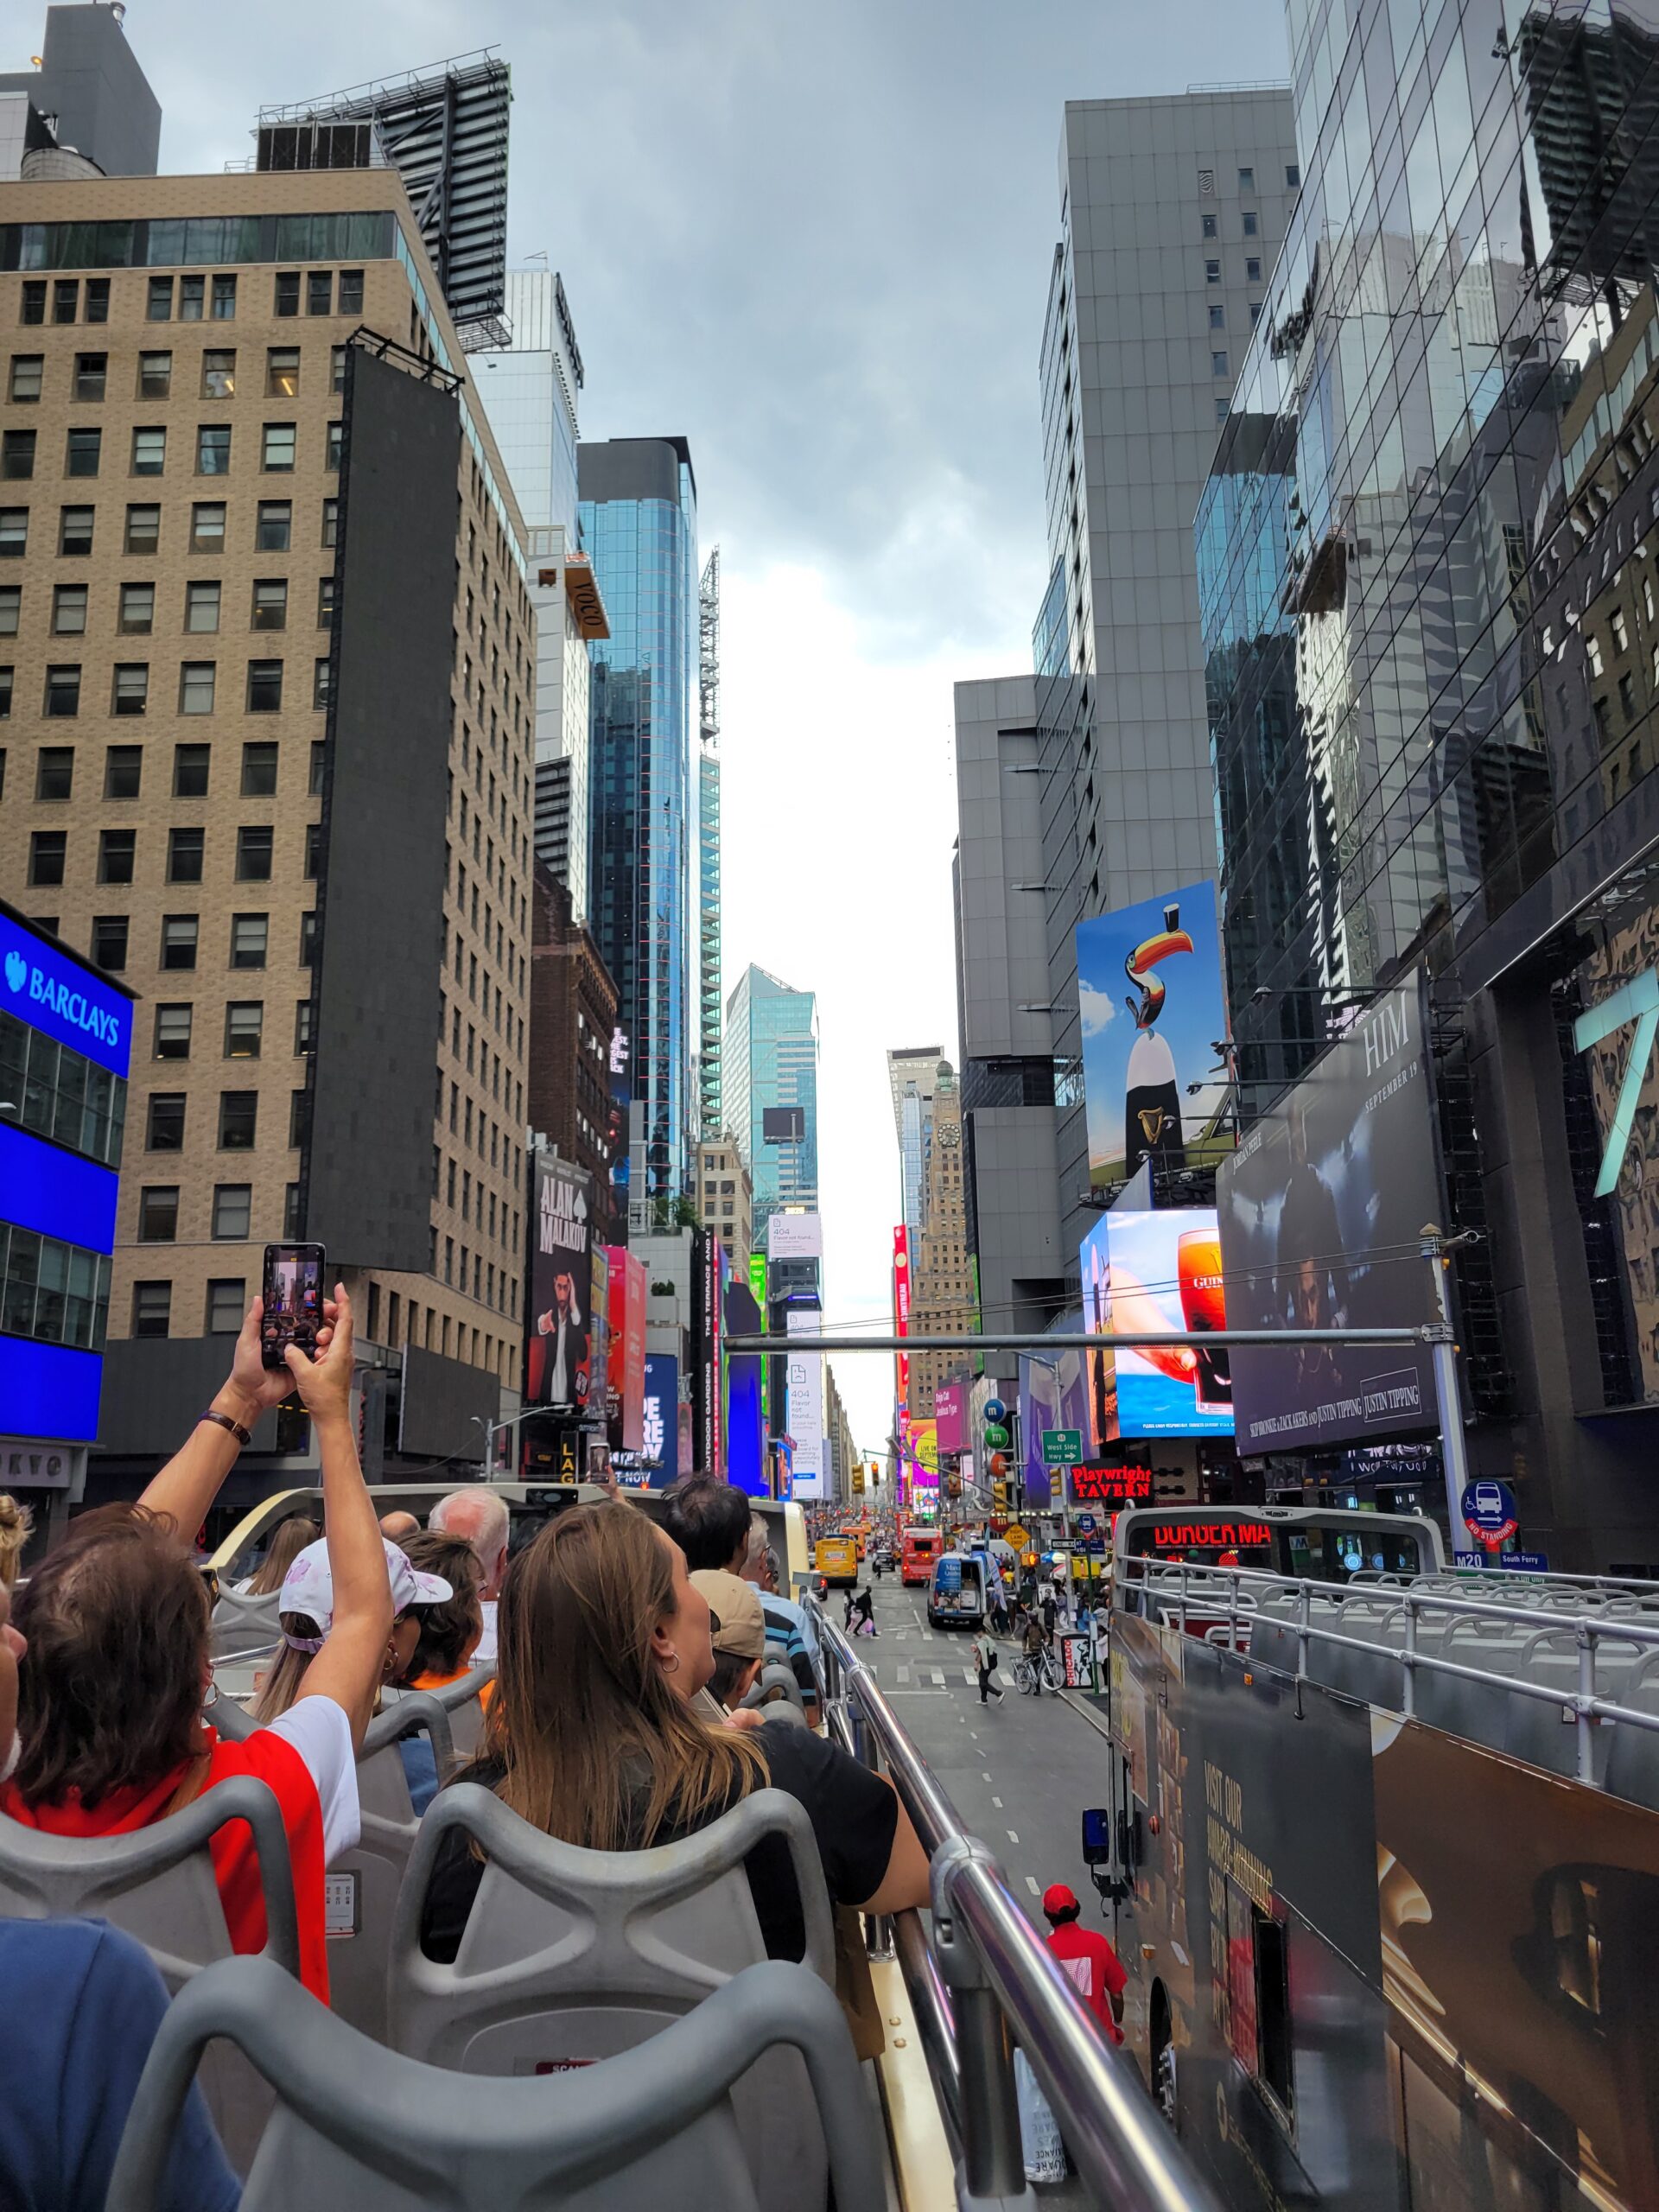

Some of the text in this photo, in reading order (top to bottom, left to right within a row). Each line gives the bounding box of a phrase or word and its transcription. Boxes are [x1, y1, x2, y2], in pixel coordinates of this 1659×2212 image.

[29, 967, 119, 1046] BARCLAYS
[1363, 989, 1409, 1077] HIM
[1364, 1061, 1418, 1114] SEPTEMBER 19
[540, 1175, 574, 1221] ALAN
[539, 1212, 587, 1255] MALAKOV
[988, 1407, 997, 1416] m
[1294, 1410, 1308, 1429] AKERS
[1317, 1403, 1337, 1428] JUSTIN
[1337, 1397, 1362, 1419] TIPPING
[1363, 1385, 1419, 1419] JUSTIN TIPPING
[992, 1433, 1001, 1442] m
[0, 1453, 62, 1478] KYO
[1071, 1465, 1152, 1484] Playwright
[1076, 1484, 1150, 1497] TAVERN
[1468, 1522, 1513, 1541] NO STANDING
[1457, 1554, 1483, 1568] M20
[1522, 1555, 1538, 1564] Ferry
[1065, 1640, 1075, 1686] CHICAGO
[1204, 1759, 1243, 1834] VISIT OUR
